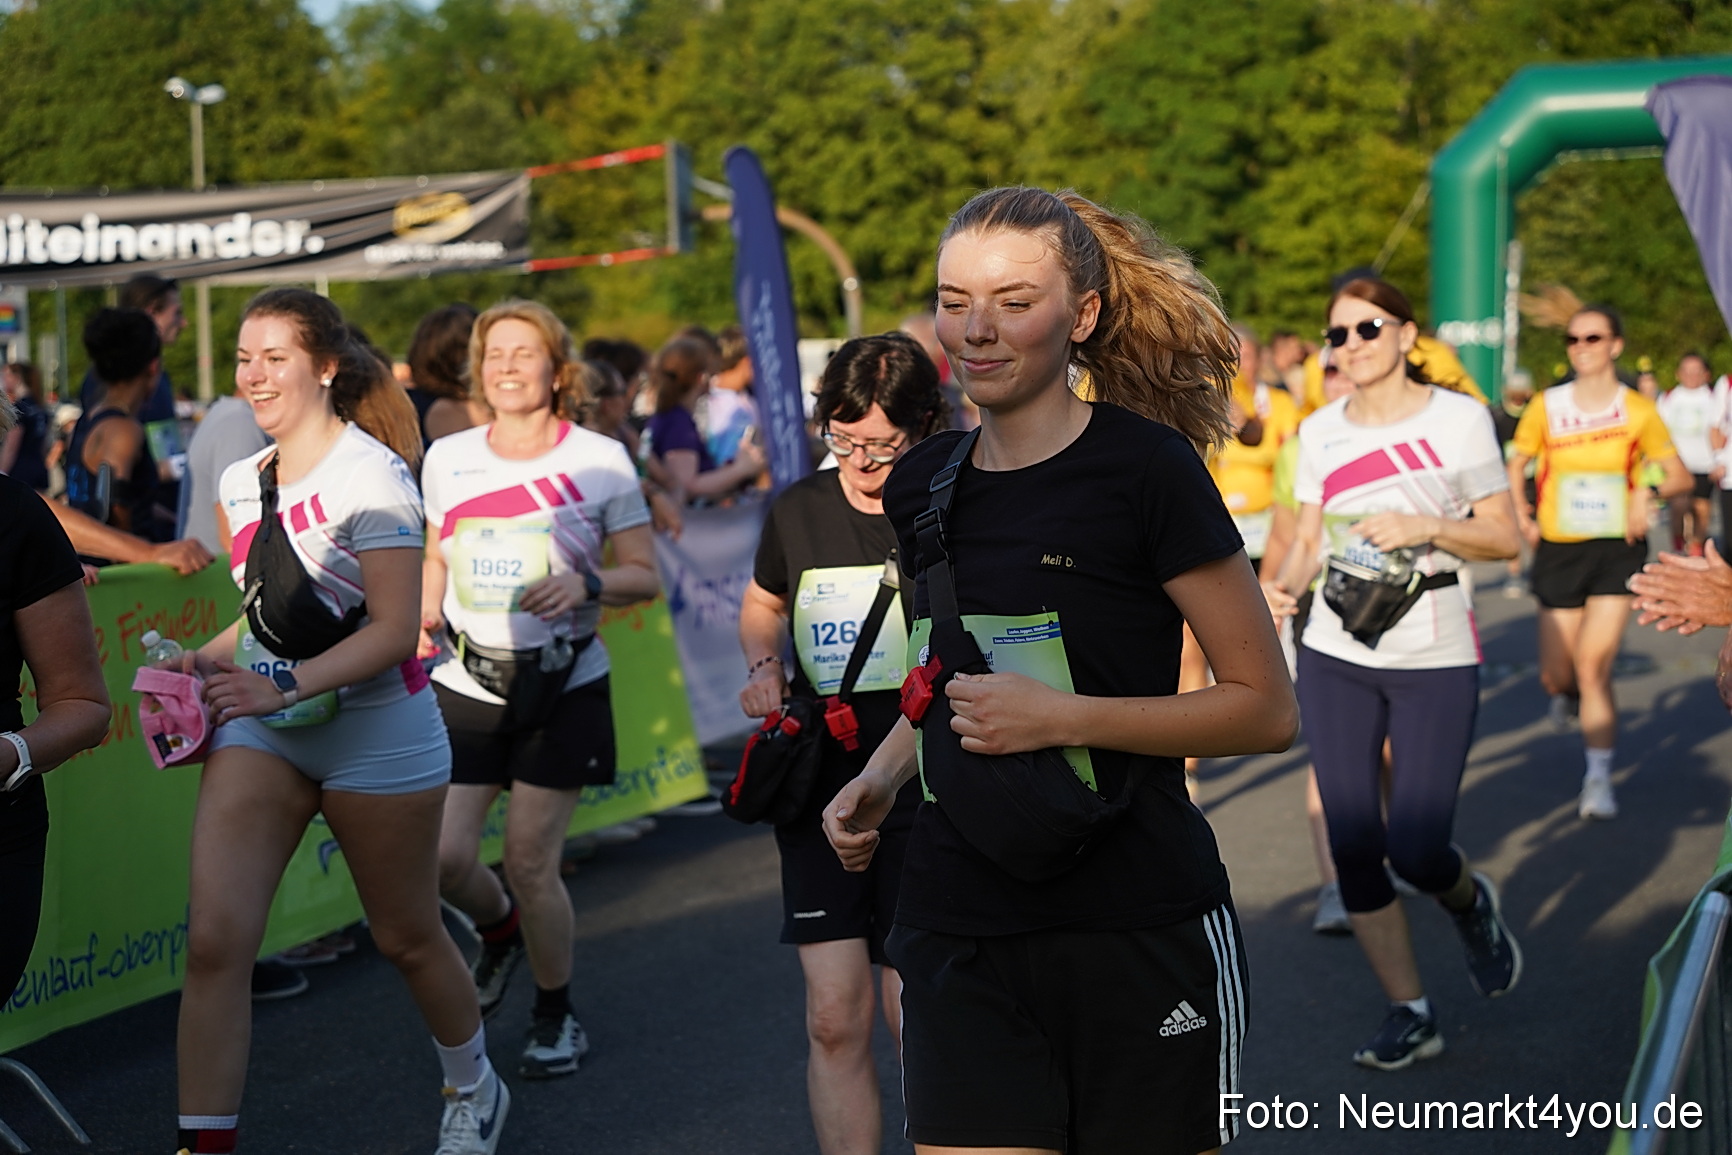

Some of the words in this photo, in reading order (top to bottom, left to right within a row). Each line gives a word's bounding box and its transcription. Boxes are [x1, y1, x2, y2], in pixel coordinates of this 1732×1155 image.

[0, 212, 325, 264] iteinander.
[472, 558, 523, 577] 1962
[1041, 554, 1062, 565] Meli
[1066, 556, 1077, 568] D.
[811, 620, 864, 647] 126
[813, 652, 846, 664] Marika
[1159, 1016, 1207, 1037] adidas
